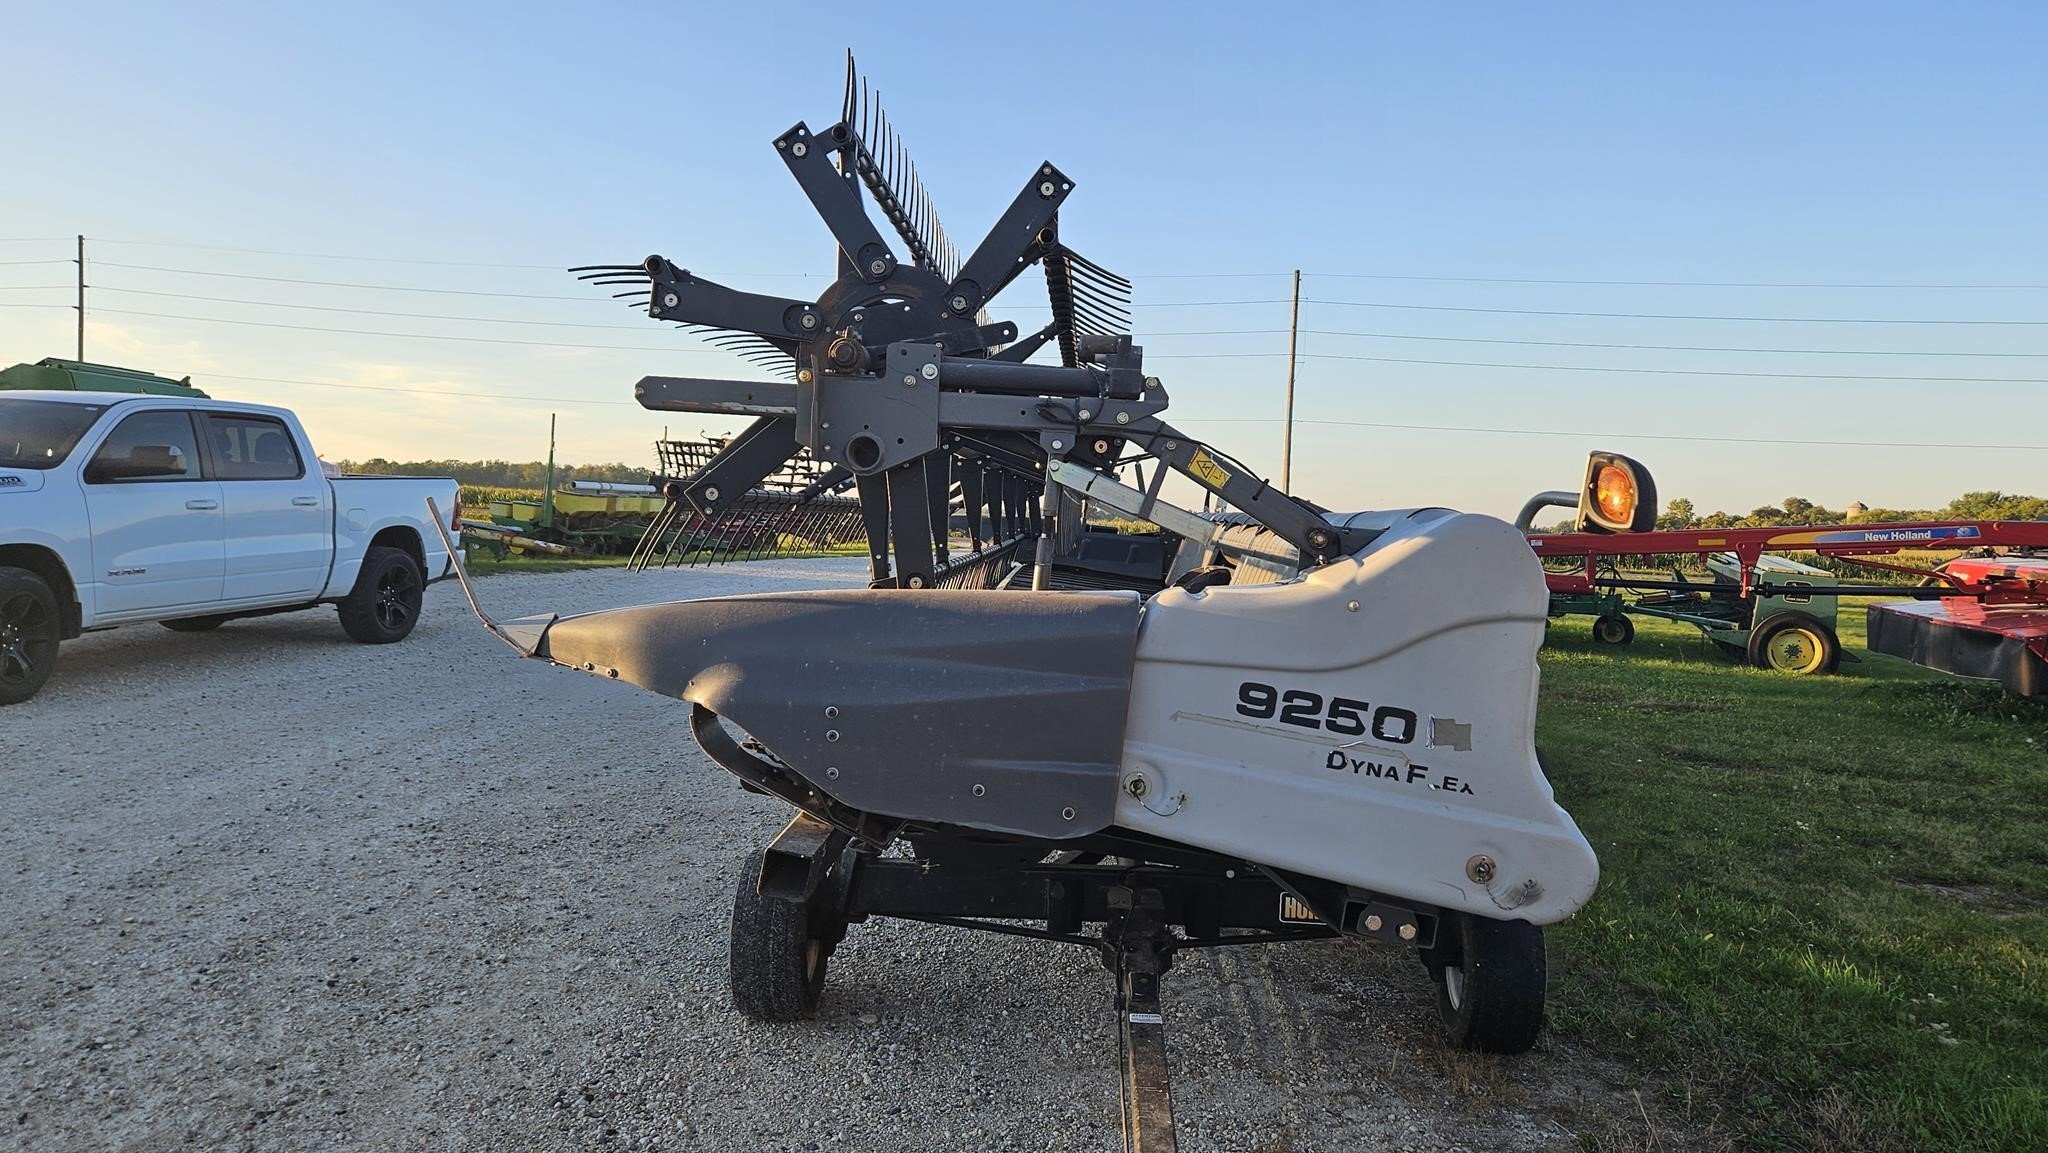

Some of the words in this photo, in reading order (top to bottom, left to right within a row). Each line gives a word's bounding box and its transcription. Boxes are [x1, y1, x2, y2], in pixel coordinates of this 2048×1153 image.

[1864, 532, 1889, 541] New
[1890, 530, 1932, 540] Holland
[1236, 682, 1418, 745] 9250
